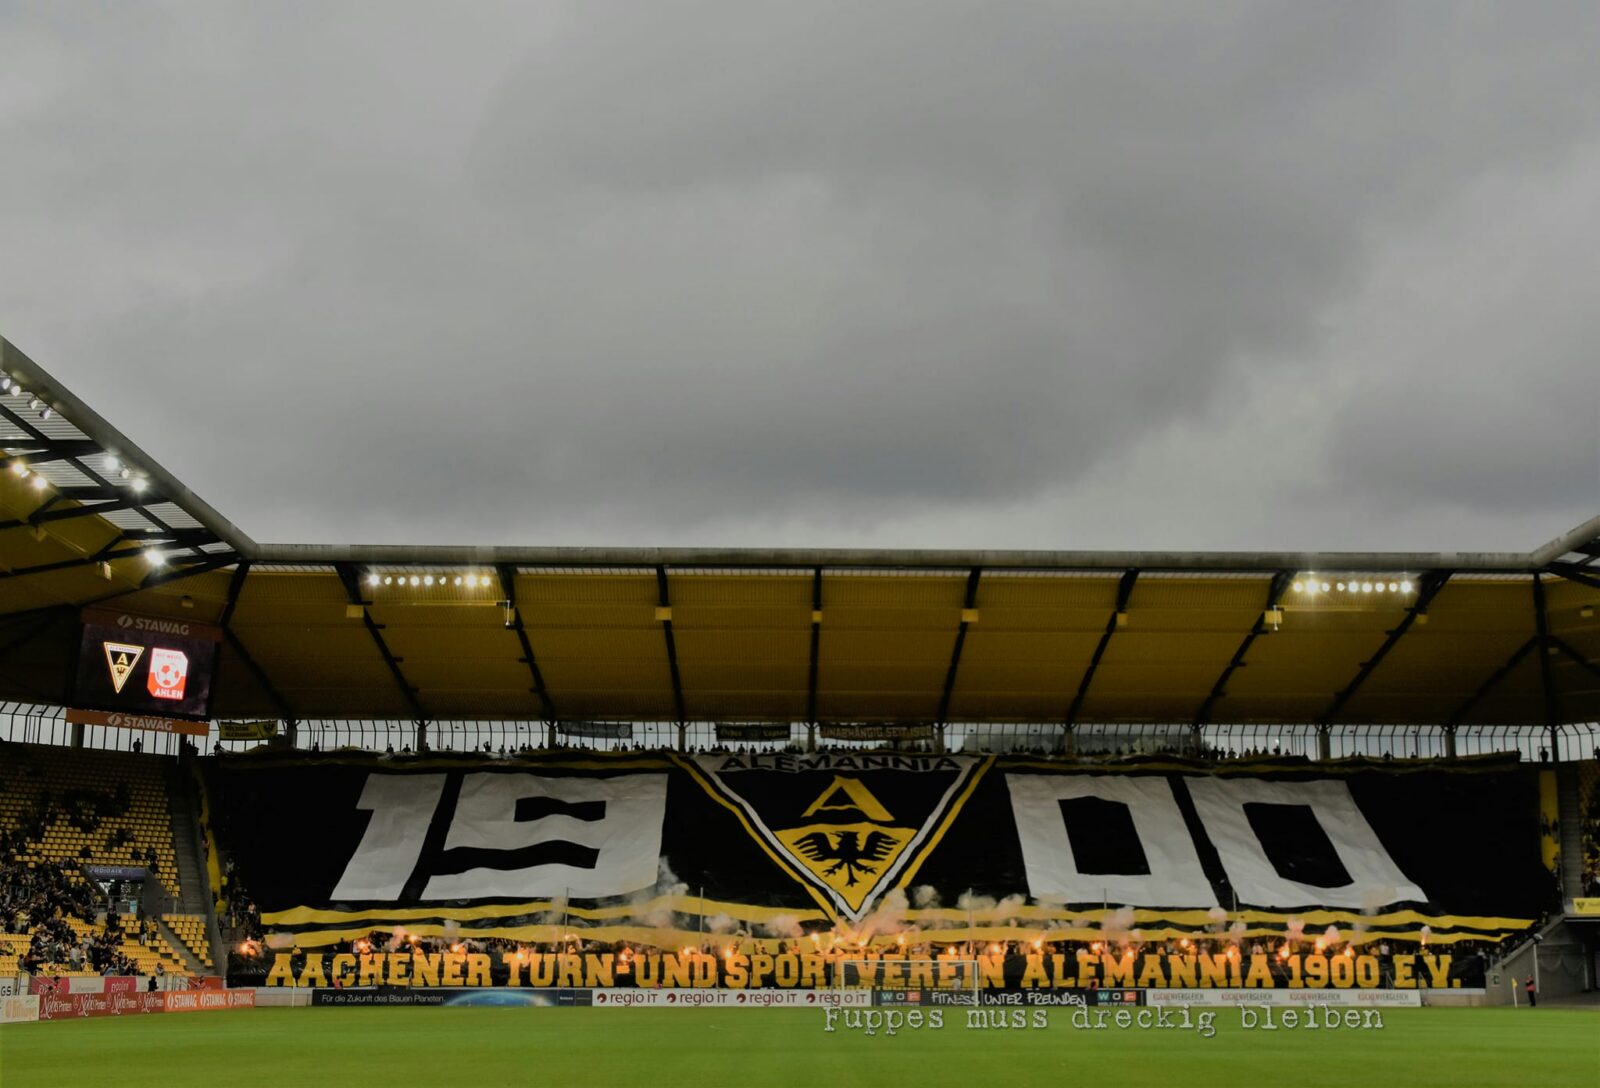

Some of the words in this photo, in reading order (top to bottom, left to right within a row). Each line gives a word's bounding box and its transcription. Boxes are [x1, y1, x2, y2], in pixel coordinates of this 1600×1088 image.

[135, 617, 189, 636] STAWAG
[154, 687, 183, 699] AHLEN
[123, 716, 173, 731] STAWAG
[720, 754, 962, 772] ALEMANNIA
[265, 953, 493, 987] AACHENER
[1020, 953, 1276, 988] ALEMANNIA
[1287, 955, 1380, 988] 1900
[1393, 954, 1461, 988] E.V.
[174, 994, 197, 1008] STAWAG
[206, 993, 226, 1006] STAWAG
[234, 992, 253, 1005] STAWAG
[321, 994, 333, 1003] Für
[334, 994, 345, 1003] die
[346, 994, 373, 1003] Zukunft
[374, 994, 387, 1003] des
[388, 994, 413, 1003] Blauen
[610, 992, 645, 1006] regio
[679, 992, 714, 1006] regio
[749, 992, 784, 1006] regio
[819, 992, 852, 1006] rego
[931, 992, 979, 1004] FITNESS
[984, 993, 1024, 1005] UNTER
[1027, 992, 1087, 1006] FREUNDEN
